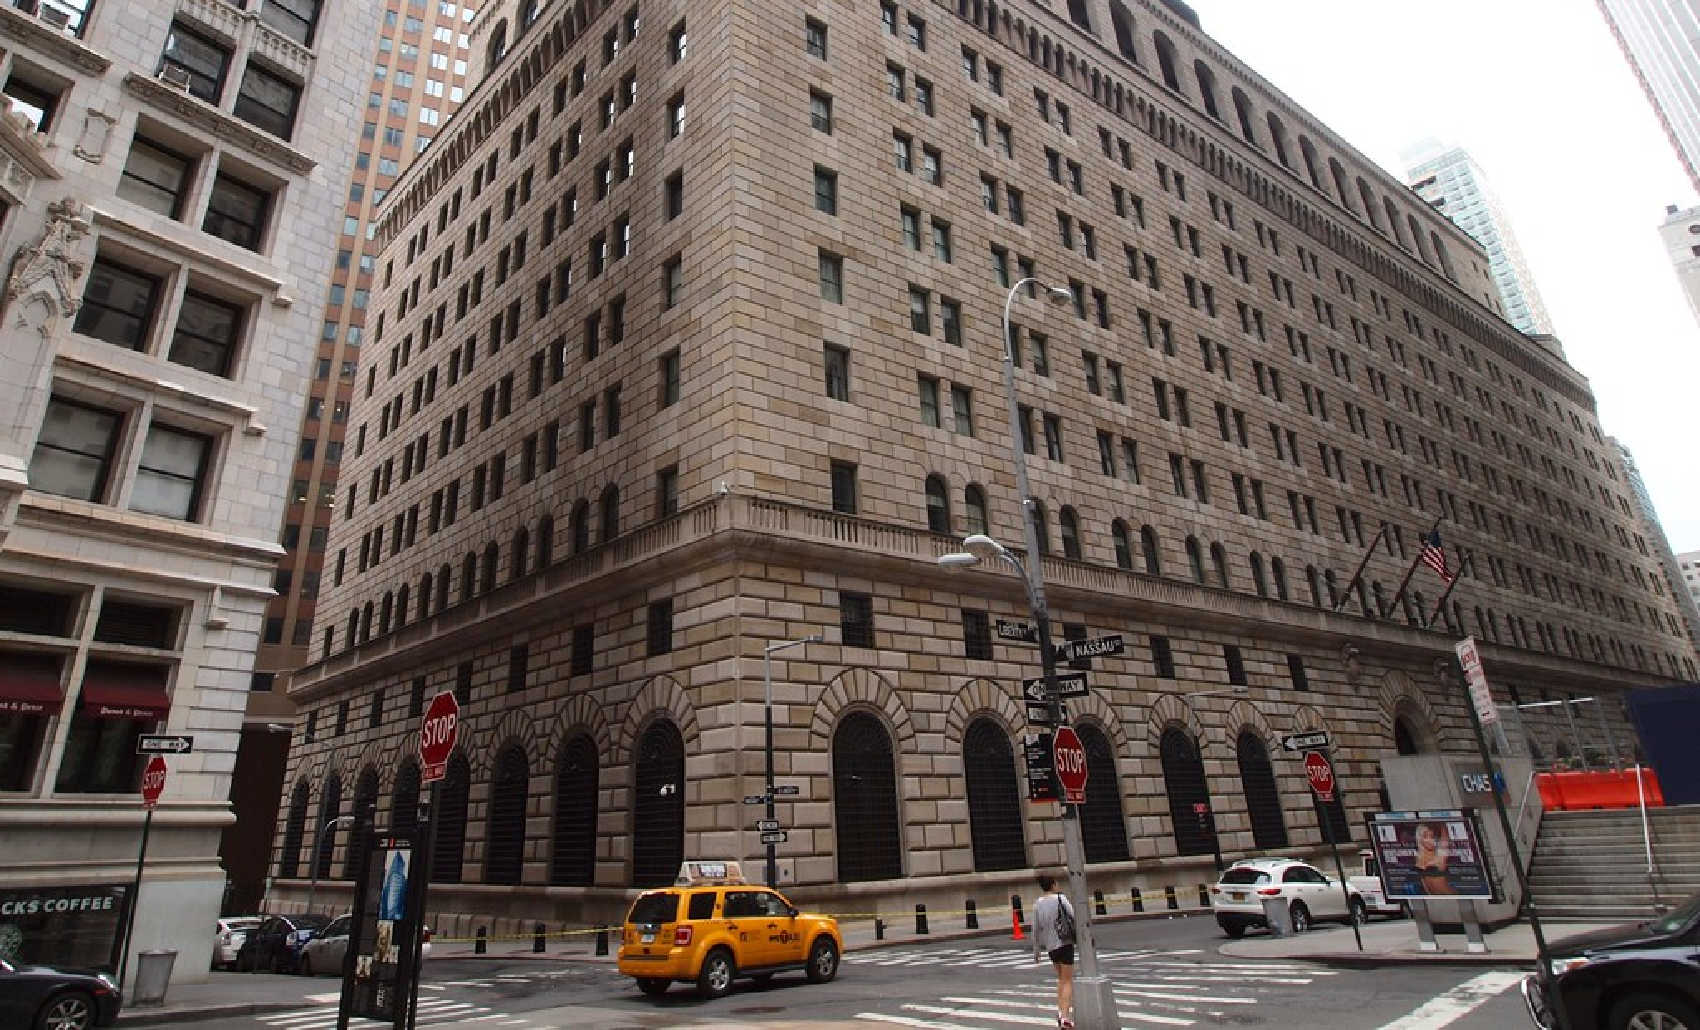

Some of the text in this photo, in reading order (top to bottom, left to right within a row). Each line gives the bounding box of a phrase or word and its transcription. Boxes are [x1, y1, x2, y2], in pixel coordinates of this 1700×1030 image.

[1075, 639, 1116, 657] NASSAU
[423, 713, 456, 748] STOP
[1057, 747, 1083, 774] STOP
[143, 770, 165, 790] STOP
[1307, 765, 1329, 782] STOP
[1462, 773, 1492, 792] CHAS
[2, 896, 113, 915] CKS COFFEE
